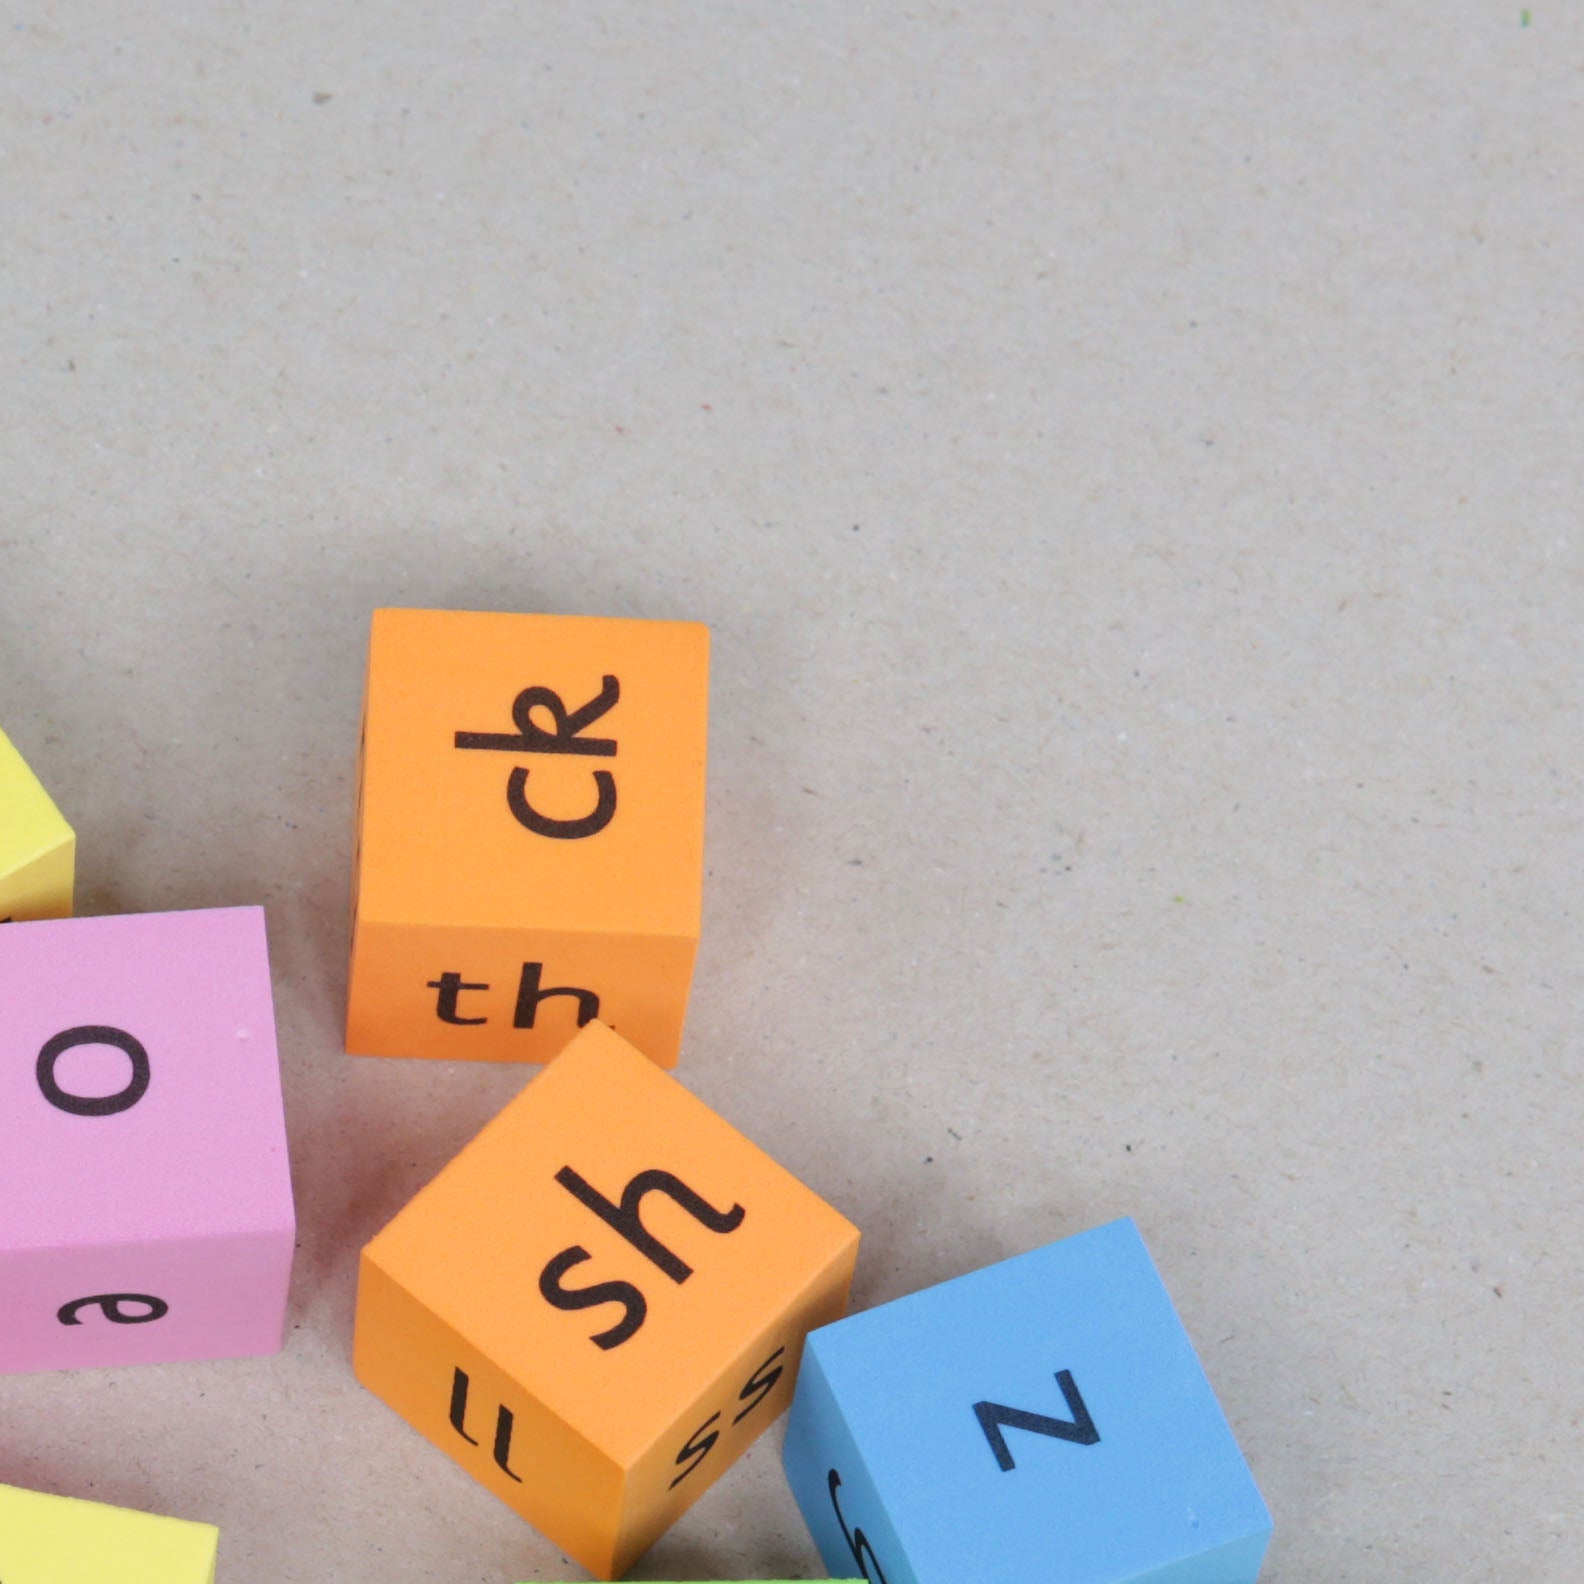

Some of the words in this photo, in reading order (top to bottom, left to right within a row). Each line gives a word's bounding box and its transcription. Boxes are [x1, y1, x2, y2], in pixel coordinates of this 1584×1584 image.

[456, 677, 618, 839] ck
[427, 962, 615, 1030] th
[37, 1026, 150, 1116] o
[540, 1168, 744, 1349] sh
[668, 1345, 786, 1490] ss
